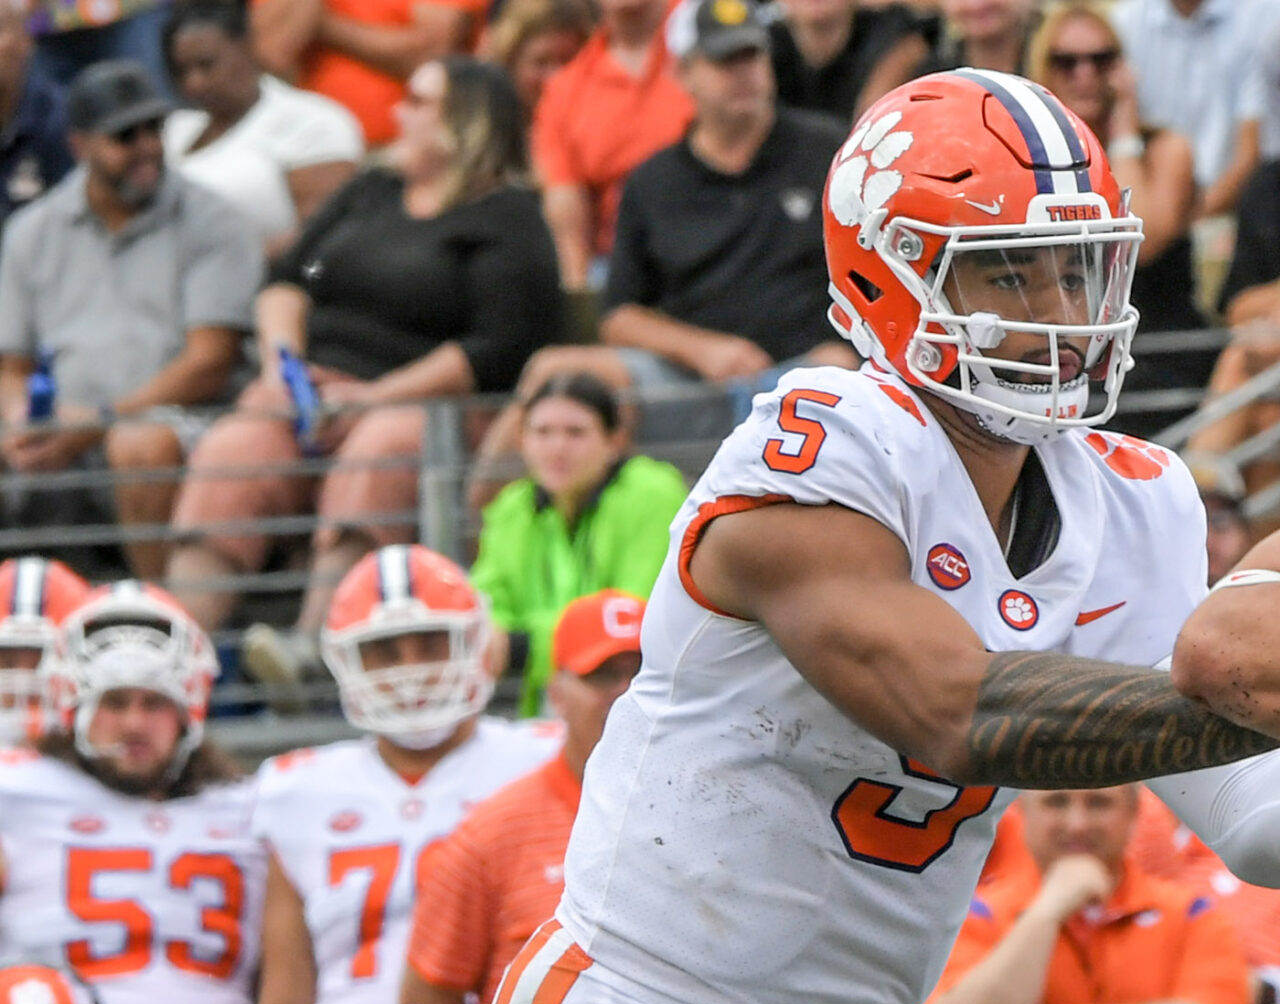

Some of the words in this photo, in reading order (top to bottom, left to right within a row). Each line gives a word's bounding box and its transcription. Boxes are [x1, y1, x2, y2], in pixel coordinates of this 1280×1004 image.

[1045, 204, 1101, 222] TIGERS
[762, 388, 843, 475] 5
[931, 552, 967, 579] ACC
[602, 597, 640, 638] C
[65, 845, 246, 983] 53
[326, 838, 440, 980] 7
